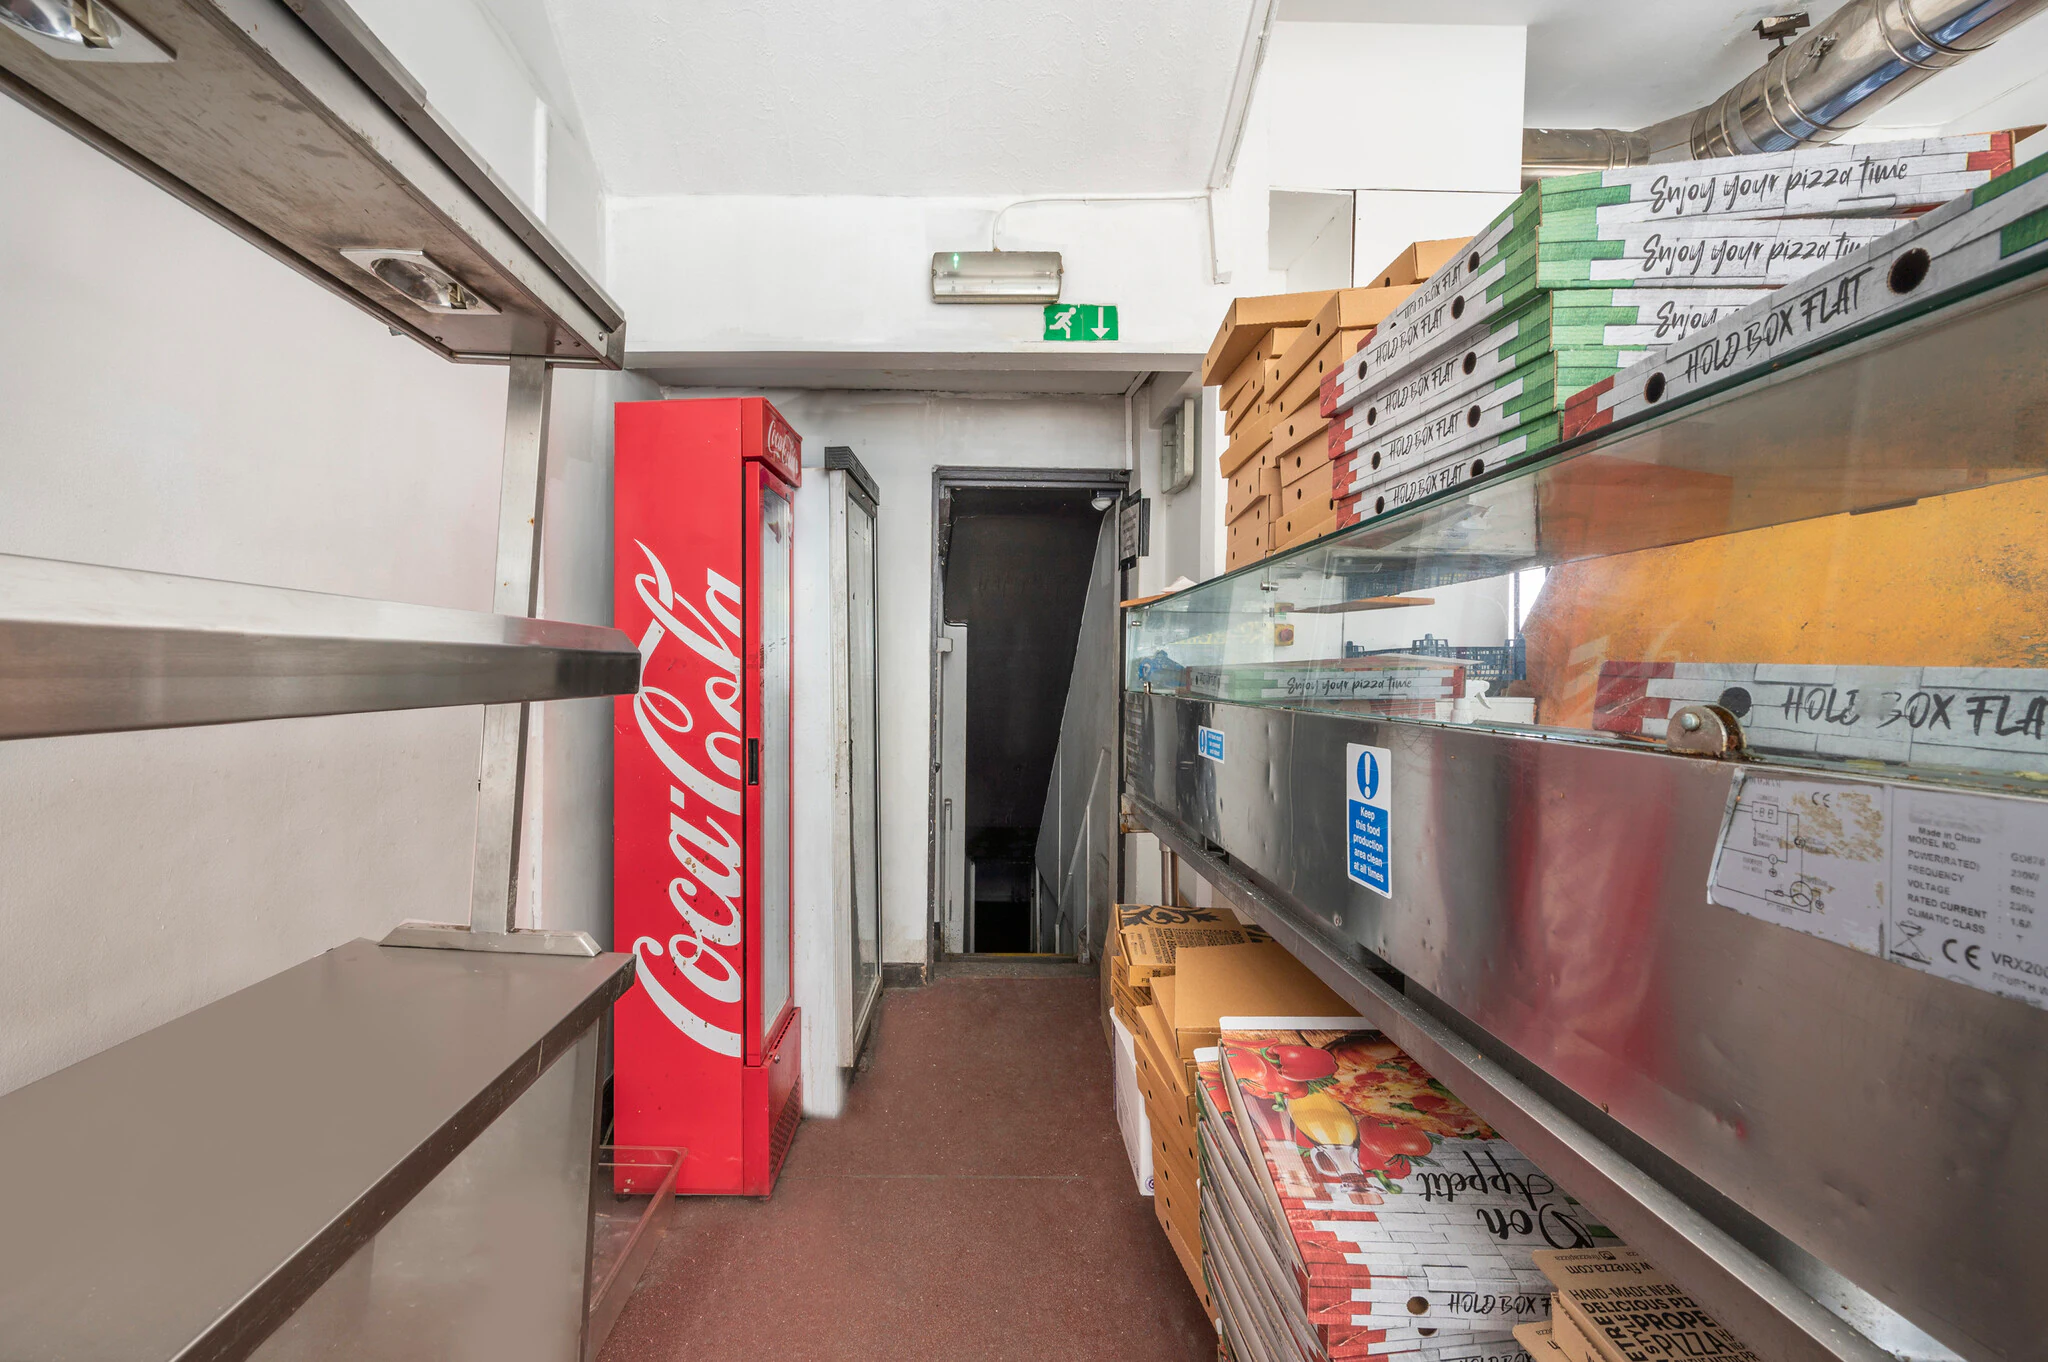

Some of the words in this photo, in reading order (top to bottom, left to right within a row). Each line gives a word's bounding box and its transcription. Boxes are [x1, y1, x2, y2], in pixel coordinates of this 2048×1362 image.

[1650, 175, 1716, 215] Enjoy
[1724, 173, 1780, 210] your
[1785, 166, 1853, 204] pizza
[1859, 156, 1908, 193] time
[1643, 234, 1705, 276] Enjoy
[1711, 239, 1763, 275] your
[1767, 239, 1830, 274] pizza
[1376, 336, 1399, 367] HOLD
[1399, 321, 1419, 353] BOX
[1420, 303, 1447, 338] FLAT
[1685, 330, 1740, 383] HOLD
[1744, 305, 1794, 359] BOX
[1800, 266, 1874, 332] FLAT
[1385, 386, 1409, 415] HOLD
[1410, 374, 1430, 403] BOX
[1431, 357, 1459, 387] FLAT
[1389, 434, 1413, 461] HOLD
[1414, 423, 1434, 451] BOX
[1436, 410, 1463, 440] FLAT
[1393, 481, 1417, 507] HOLD
[1418, 472, 1438, 498] BOX
[1439, 462, 1467, 491] FLAT
[1322, 679, 1349, 695] your
[1352, 678, 1385, 695] pizza
[1388, 675, 1413, 689] time
[633, 538, 741, 1058] Coca-Cola
[1360, 806, 1376, 822] Keep
[1355, 818, 1367, 832] this
[1366, 822, 1381, 837] food
[1918, 826, 1942, 839] Made
[1944, 829, 1952, 840] in
[1954, 832, 1982, 845] China
[1353, 833, 1384, 854] production
[1907, 834, 1940, 849] MODEL
[1353, 848, 1367, 861] area
[1366, 852, 1383, 868] clean
[1353, 861, 1360, 871] at
[1360, 863, 1368, 875] all
[1367, 866, 1384, 884] times
[1907, 863, 1965, 883] FREQUENCY
[1906, 879, 1952, 896] VOLTAGE
[1906, 893, 1939, 909] RATED
[1939, 901, 1989, 920] CURRENT
[1906, 907, 1950, 926] CLIMATIC
[1952, 918, 1987, 935] CLASS
[1416, 1150, 1555, 1212] Appetit
[1448, 1293, 1496, 1315] HOLD
[1500, 1295, 1536, 1316] BOX
[1569, 1285, 1650, 1301] HAND-MADE
[1580, 1299, 1671, 1315] DELICIOUS
[1649, 1330, 1735, 1359] PIZZA
